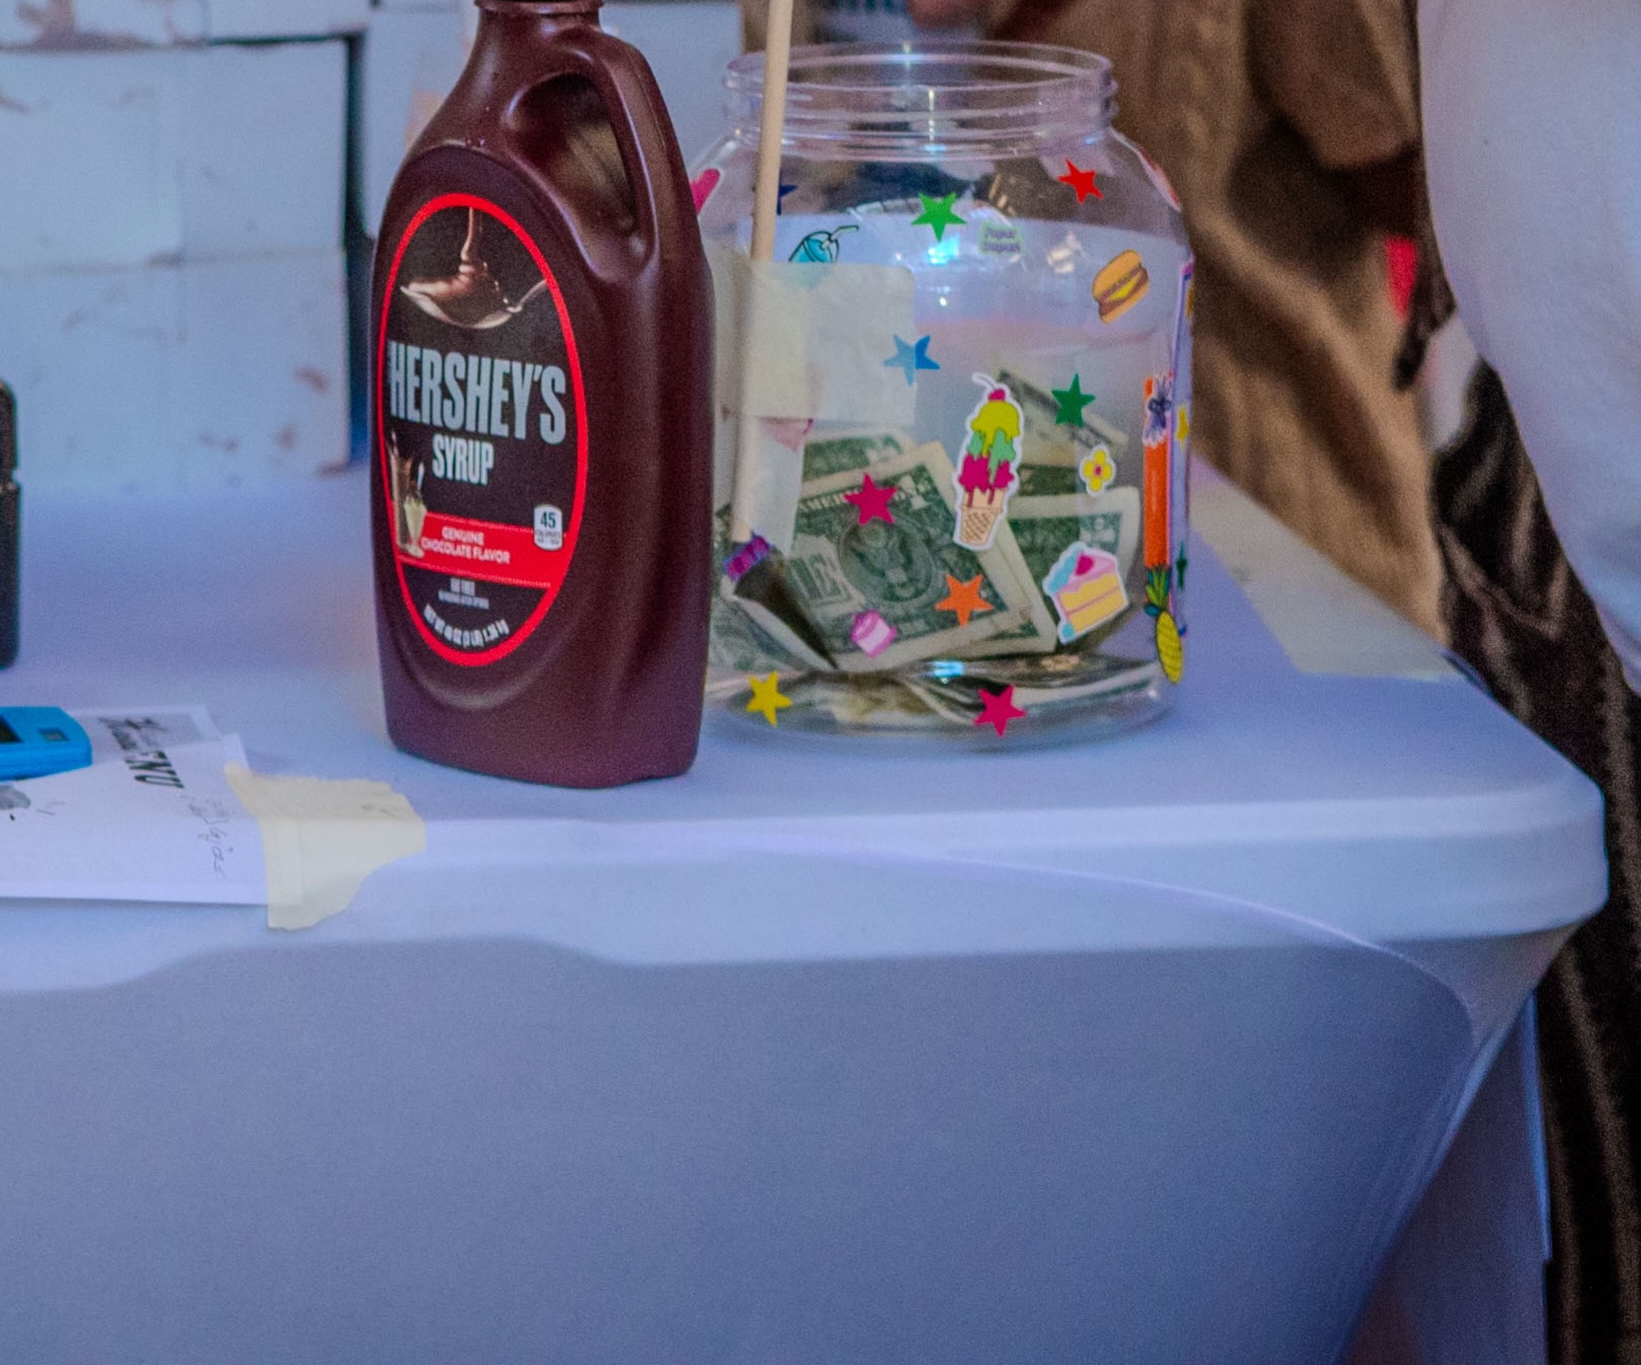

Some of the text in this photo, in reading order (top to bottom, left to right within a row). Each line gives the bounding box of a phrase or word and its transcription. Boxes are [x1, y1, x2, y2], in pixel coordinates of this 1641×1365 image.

[388, 341, 567, 446] HERSHEY'S
[432, 433, 495, 486] SYRUP
[540, 511, 557, 529] 45
[420, 536, 511, 565] CHOCOLATE FLAVOR
